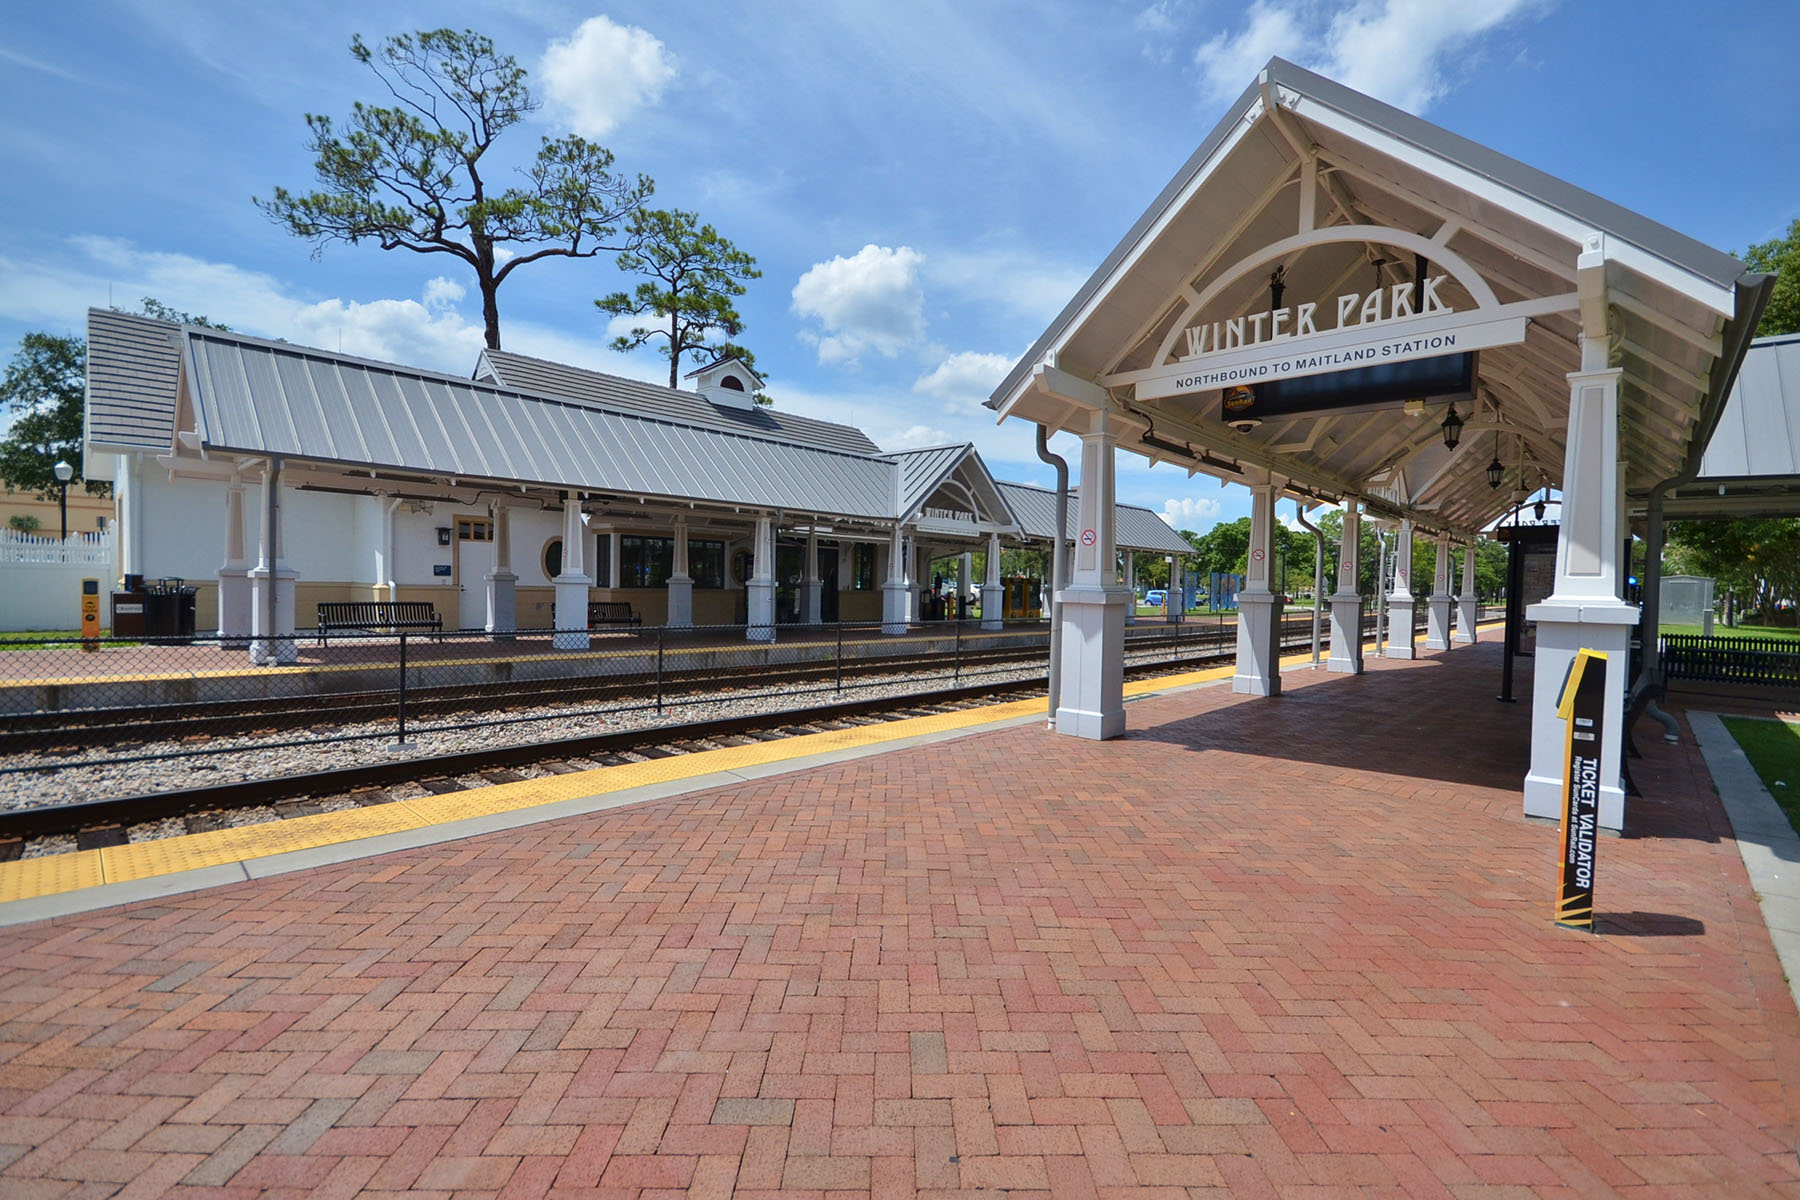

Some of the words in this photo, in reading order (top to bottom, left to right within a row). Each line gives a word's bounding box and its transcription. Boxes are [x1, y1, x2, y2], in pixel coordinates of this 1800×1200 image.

[1184, 302, 1317, 358] WINTER
[1337, 275, 1452, 330] PARK
[1176, 366, 1268, 388] NORTHBOUND
[1272, 362, 1291, 373] TO
[1296, 348, 1376, 370] MAITLAND
[1382, 335, 1456, 356] STATION
[925, 507, 954, 520] WINTER
[955, 511, 973, 521] PARK
[1573, 756, 1582, 783] Register
[1581, 758, 1597, 808] TICKET
[1572, 784, 1581, 815] SunCards
[1569, 823, 1578, 863] SunRail.com
[1576, 814, 1594, 889] VALIDATOR
